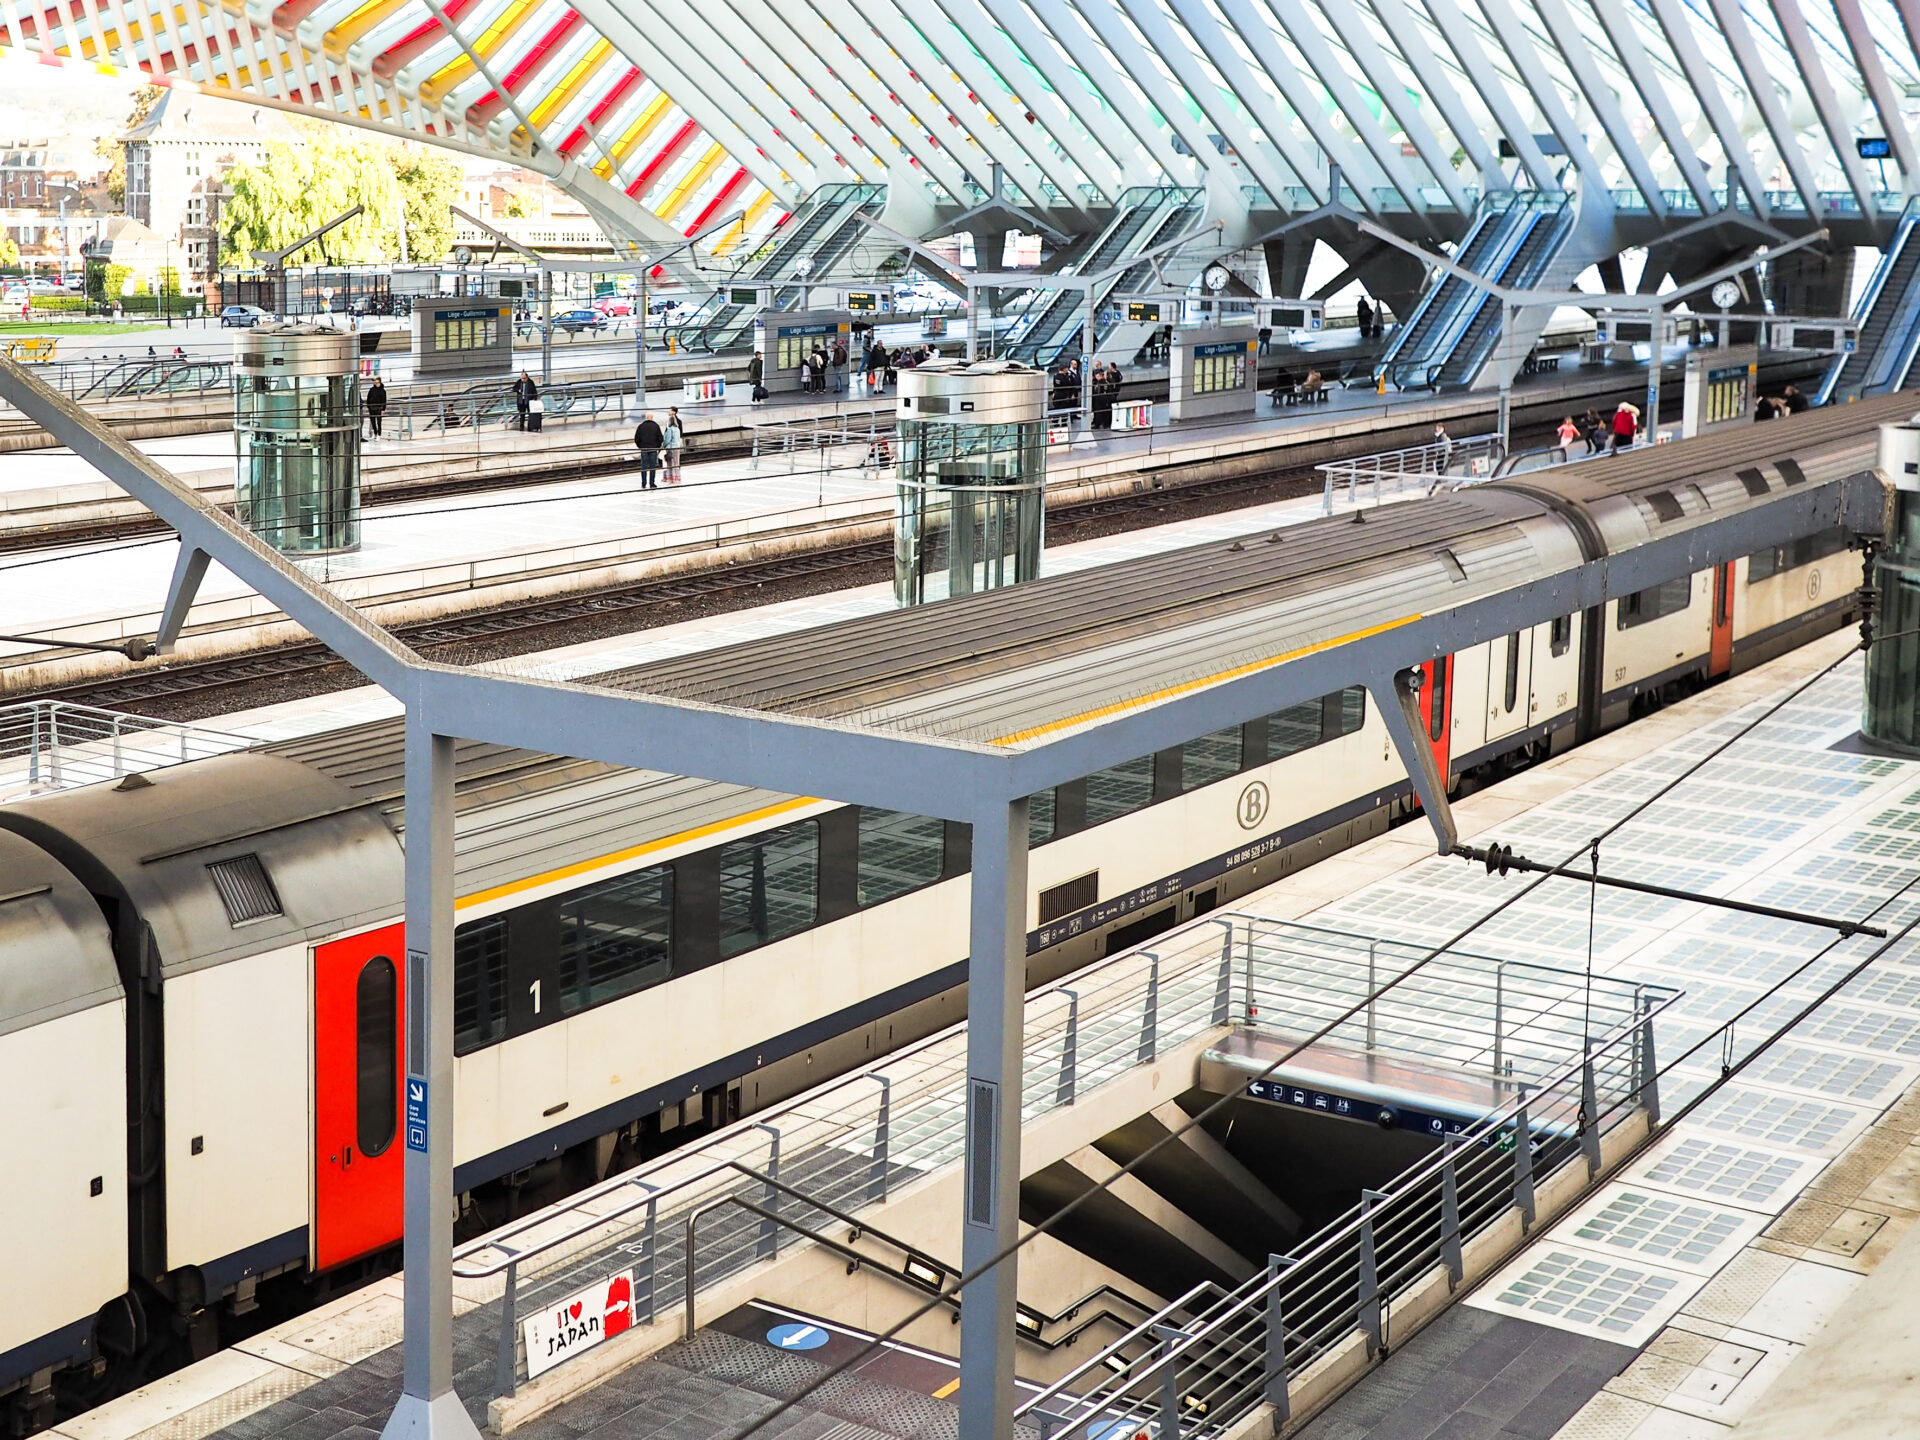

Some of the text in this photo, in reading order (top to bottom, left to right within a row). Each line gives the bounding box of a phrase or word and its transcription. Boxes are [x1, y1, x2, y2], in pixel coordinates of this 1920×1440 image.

[1778, 549, 1784, 567] 2
[1702, 577, 1708, 594] 2
[1615, 666, 1627, 682] 537
[1557, 692, 1568, 708] 528
[1226, 856, 1233, 867] 94
[1251, 844, 1260, 859] 528
[1040, 932, 1050, 945] 160
[529, 979, 541, 1015] 1
[1454, 1125, 1461, 1133] P
